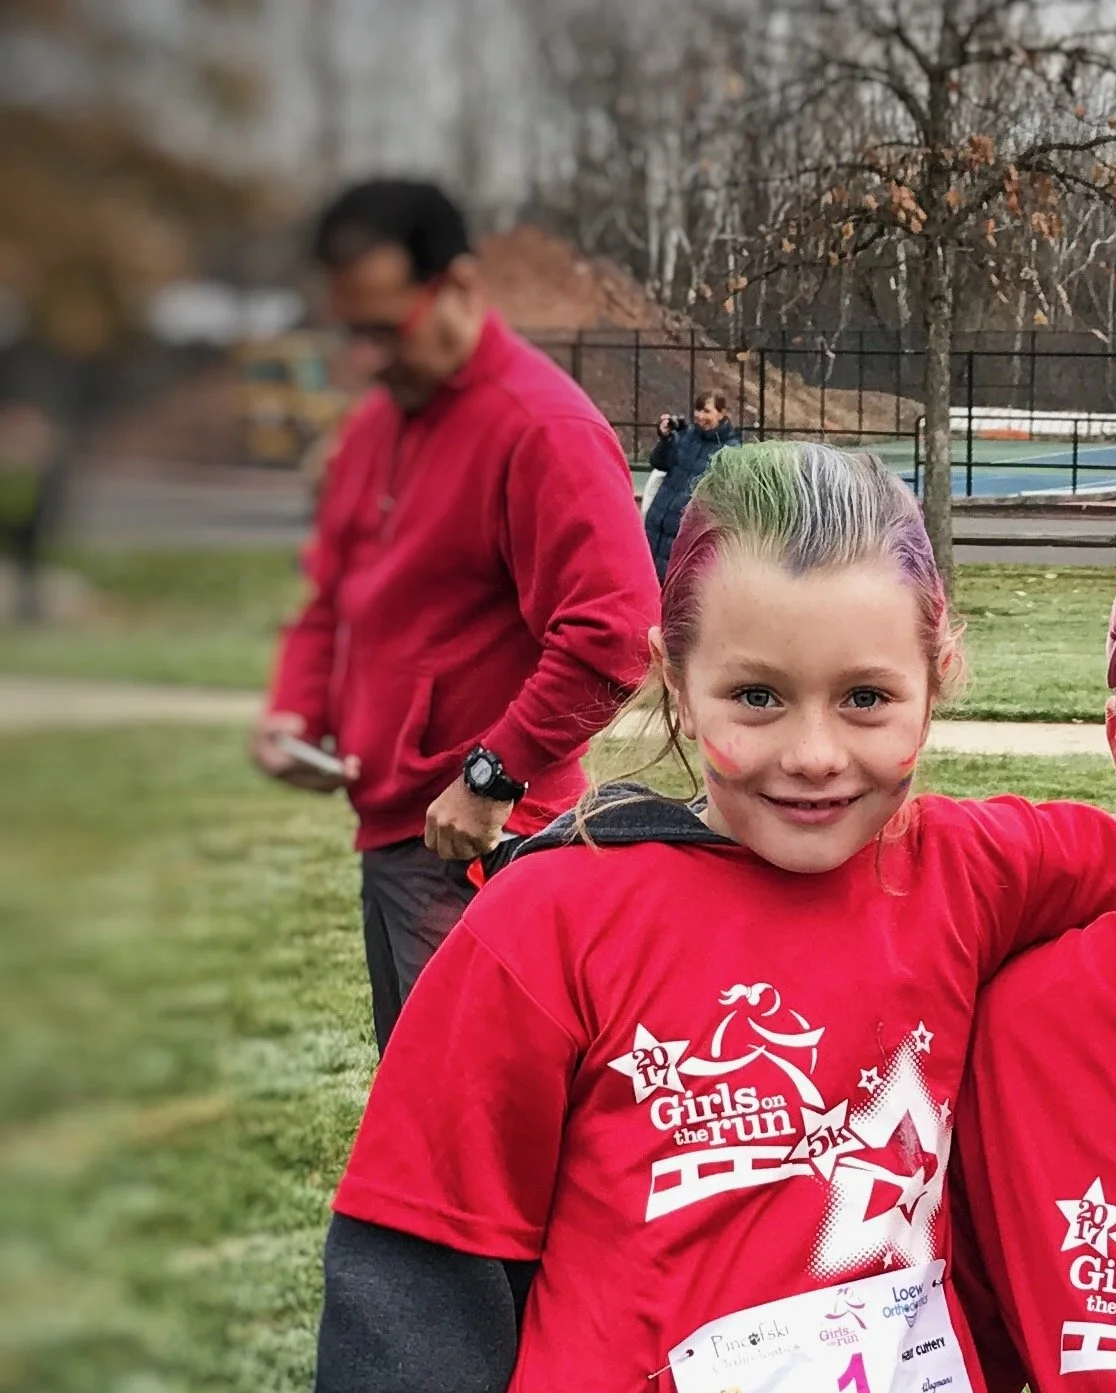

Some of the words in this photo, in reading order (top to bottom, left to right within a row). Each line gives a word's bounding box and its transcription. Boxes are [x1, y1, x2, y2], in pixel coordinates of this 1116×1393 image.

[632, 1046, 669, 1069] 20
[639, 1064, 671, 1089] 17
[650, 1082, 760, 1131] Girls
[761, 1094, 787, 1110] on
[673, 1127, 708, 1147] the
[707, 1107, 797, 1146] run
[806, 1126, 853, 1158] 5k
[1076, 1199, 1108, 1227] 20
[1073, 1218, 1104, 1245] 17
[892, 1283, 924, 1302] Loew
[1086, 1294, 1116, 1315] the
[819, 1326, 850, 1342] Girls
[836, 1333, 860, 1347] run
